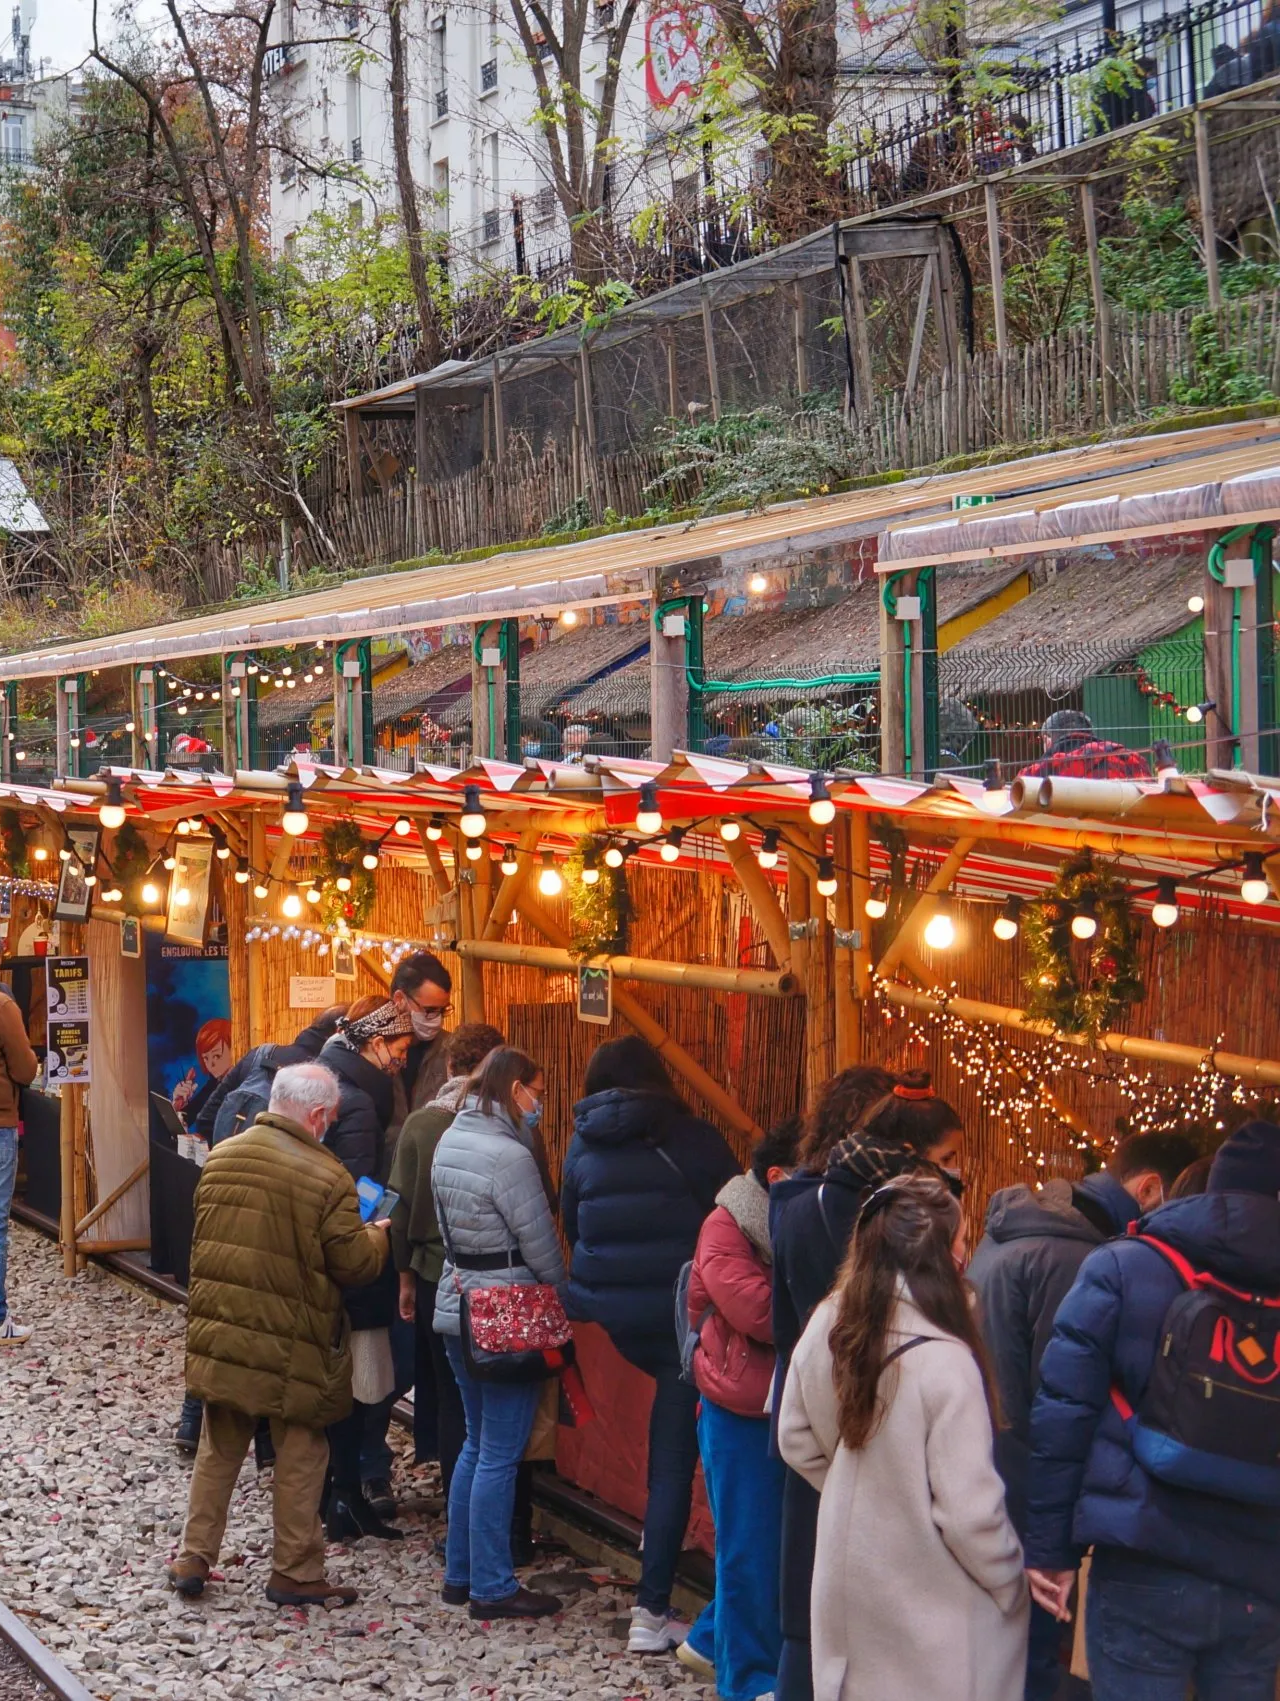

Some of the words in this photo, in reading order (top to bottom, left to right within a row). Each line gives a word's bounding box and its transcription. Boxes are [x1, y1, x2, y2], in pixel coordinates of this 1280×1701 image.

[262, 47, 286, 80] OTEL
[204, 945, 219, 957] LES
[54, 968, 82, 978] TARIFS
